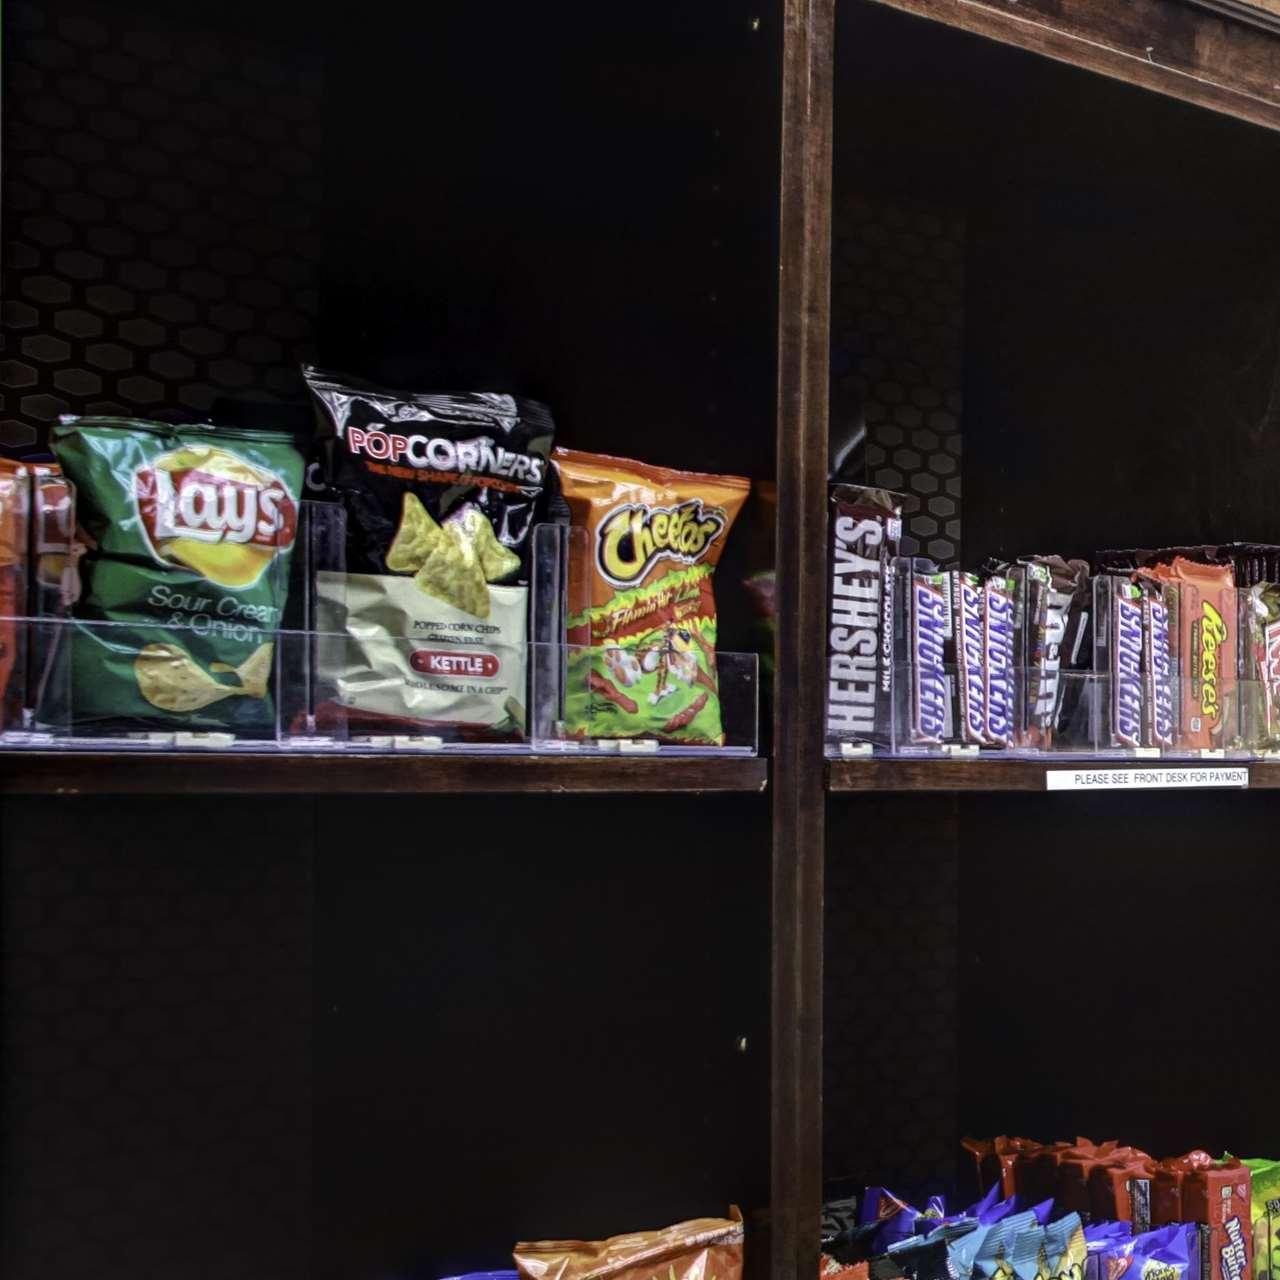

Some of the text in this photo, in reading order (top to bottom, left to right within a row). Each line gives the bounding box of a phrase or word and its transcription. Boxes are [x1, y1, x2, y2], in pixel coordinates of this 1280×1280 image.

[348, 426, 545, 483] POPCORNERS
[602, 502, 720, 580] Cheetos
[148, 585, 213, 612] Sour
[189, 613, 263, 644] Onion
[828, 516, 882, 733] HERSHEY'S
[882, 565, 895, 693] MILK CHOCOLATE
[430, 655, 484, 673] KETTLE
[917, 589, 945, 740] SNICKERS
[1119, 602, 1142, 743] SNICKERS
[1202, 601, 1228, 718] Reese's
[1074, 771, 1248, 785] PLEASE SEE FRONT DESK FOR PAYMENT
[1225, 1217, 1247, 1267] Nutter
